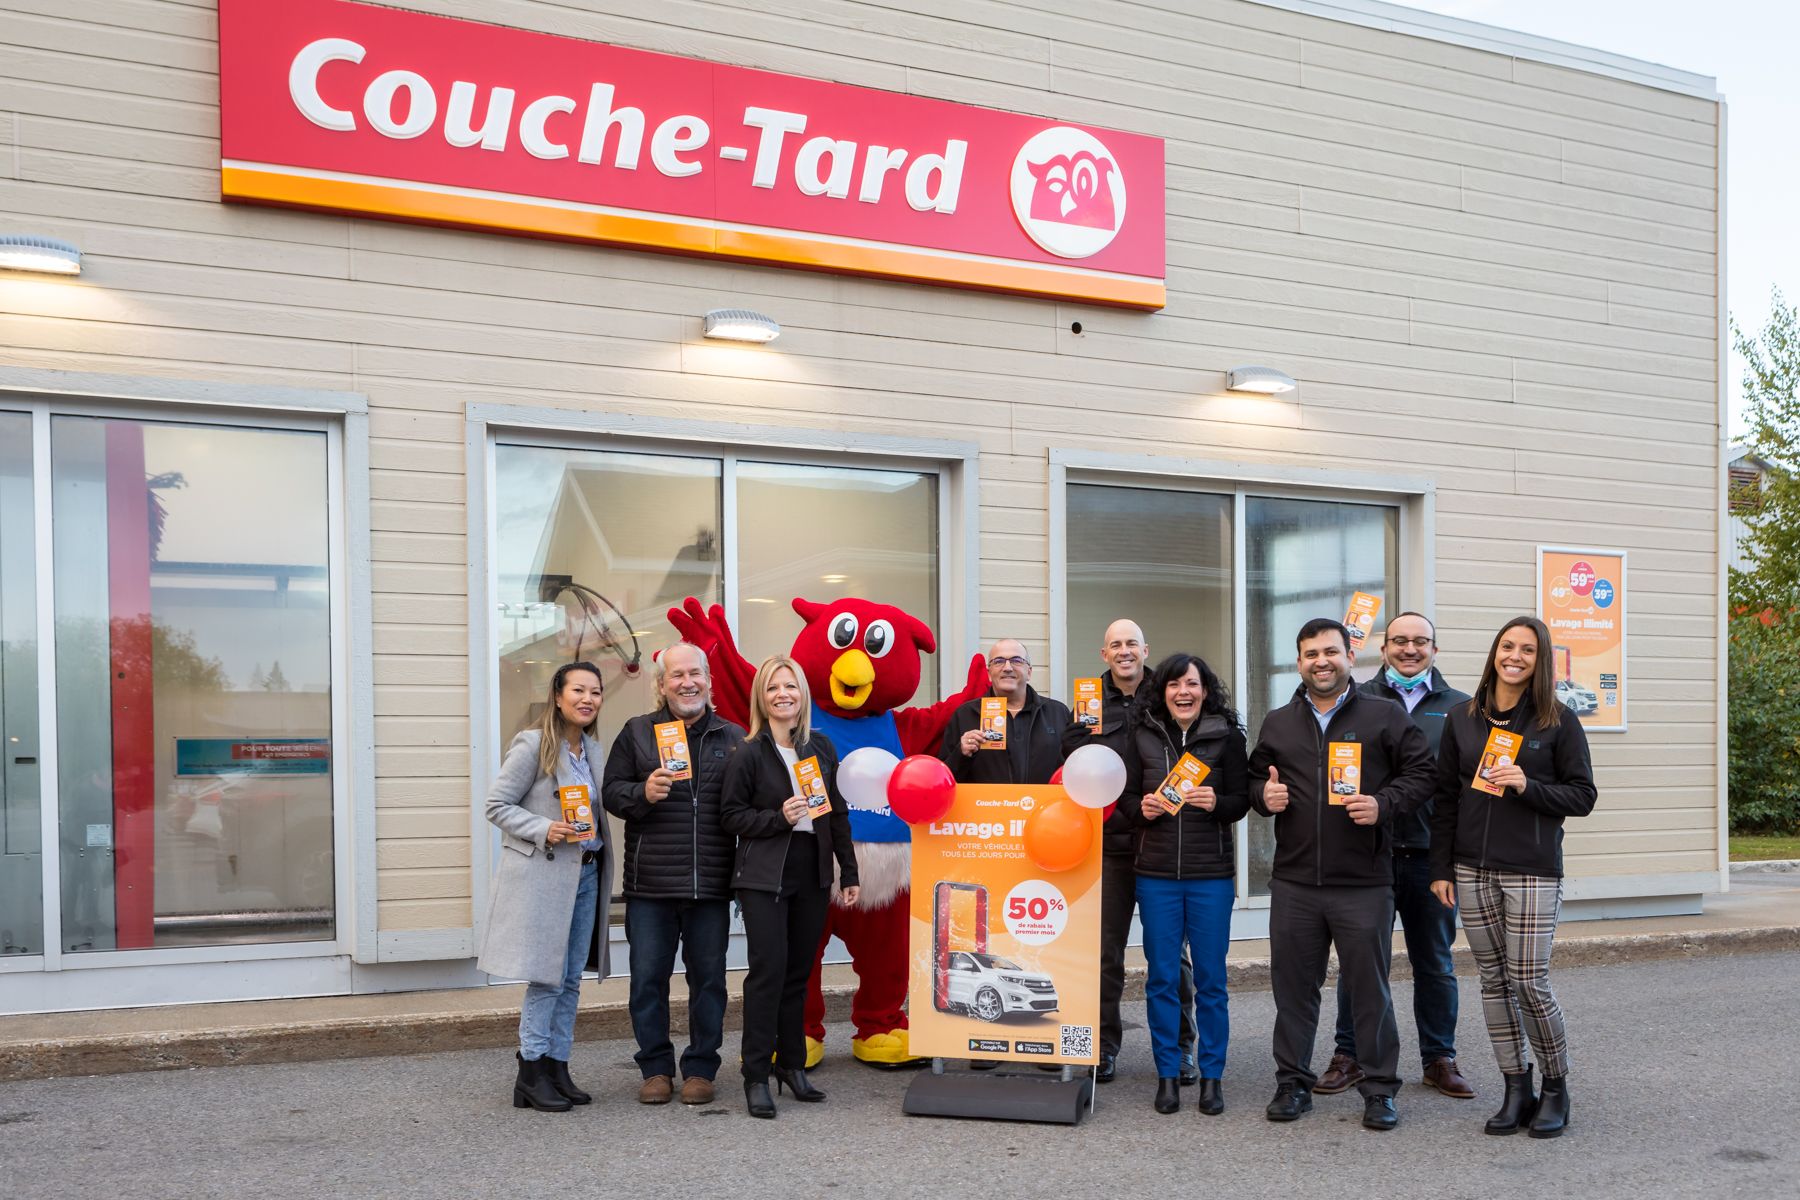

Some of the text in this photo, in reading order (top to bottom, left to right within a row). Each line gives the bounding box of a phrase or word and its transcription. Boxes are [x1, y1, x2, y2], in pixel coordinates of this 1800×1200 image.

[287, 36, 967, 215] Couche-Tard
[1570, 573, 1588, 587] 59
[1552, 587, 1566, 598] 49
[1594, 588, 1607, 600] 39
[1550, 617, 1582, 629] Lavage
[975, 799, 1020, 808] Couche-Tard
[929, 821, 1005, 839] Lavage
[957, 842, 982, 850] VOTRE
[984, 841, 1021, 851] VÉHICULE
[942, 850, 961, 858] TOUS
[978, 851, 1003, 859] JOURS
[1008, 897, 1064, 920] 50%
